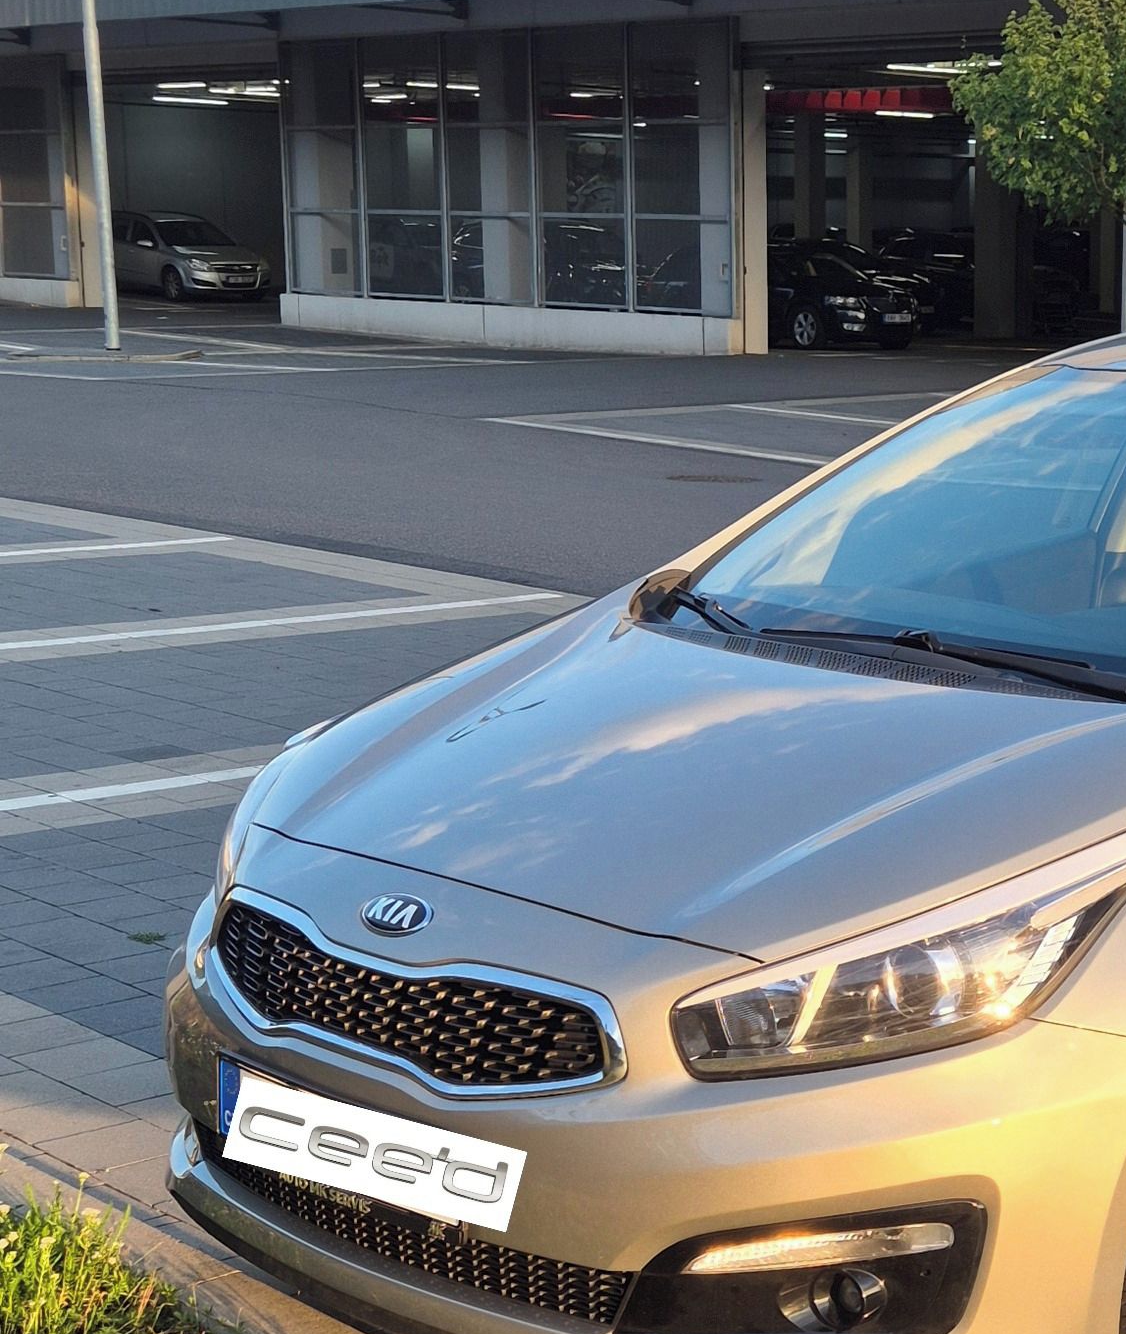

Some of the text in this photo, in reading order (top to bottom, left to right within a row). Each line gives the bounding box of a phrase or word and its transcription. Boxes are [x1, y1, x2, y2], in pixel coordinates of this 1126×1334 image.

[367, 897, 418, 929] KIA
[279, 1171, 374, 1215] AUTO MK SERVIS
